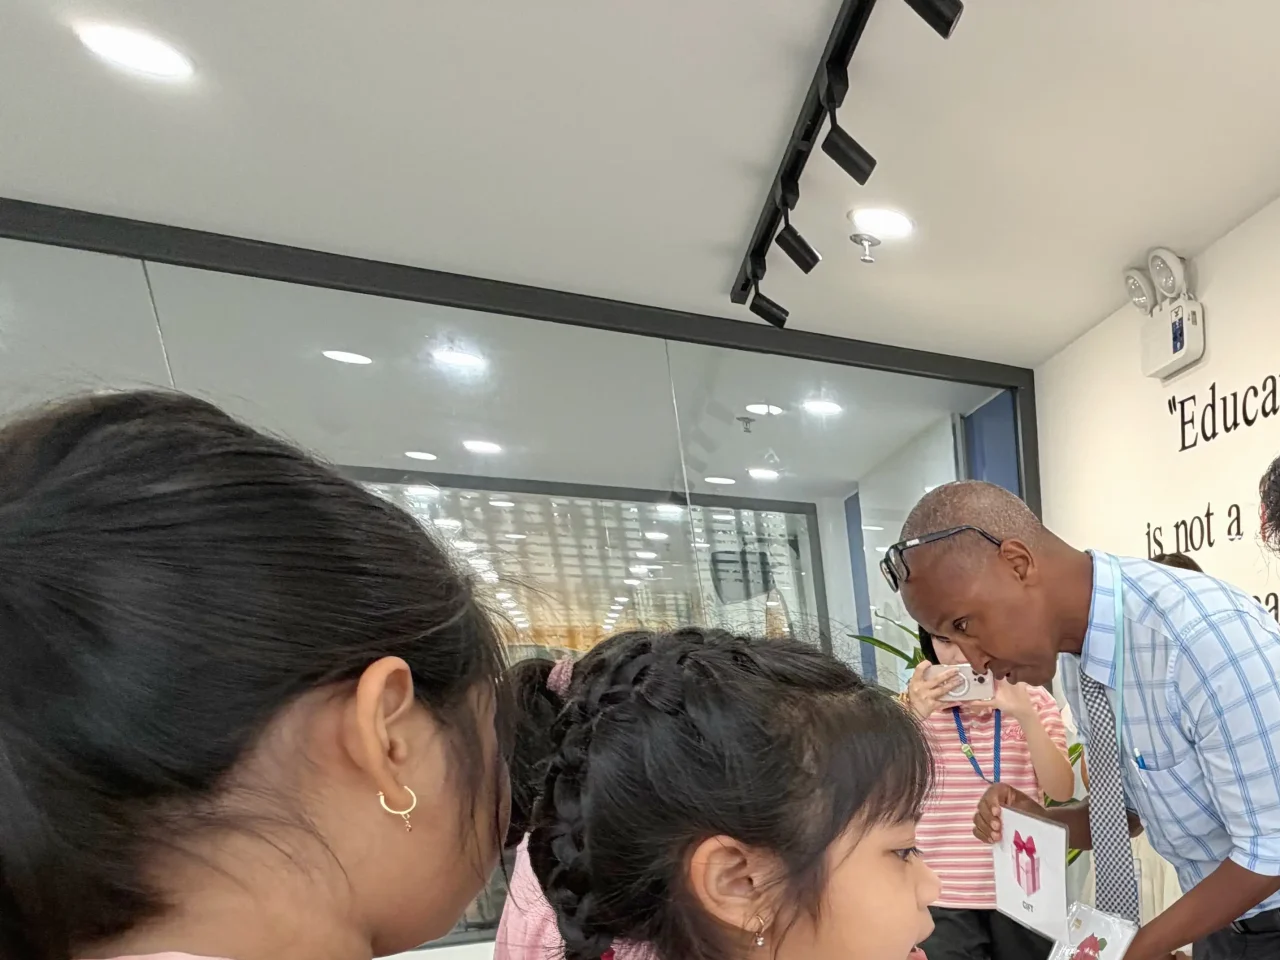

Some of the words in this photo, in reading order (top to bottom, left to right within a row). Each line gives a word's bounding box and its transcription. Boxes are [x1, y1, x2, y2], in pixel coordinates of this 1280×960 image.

[1145, 522, 1164, 560] is
[1173, 501, 1215, 554] not
[1227, 503, 1244, 541] a
